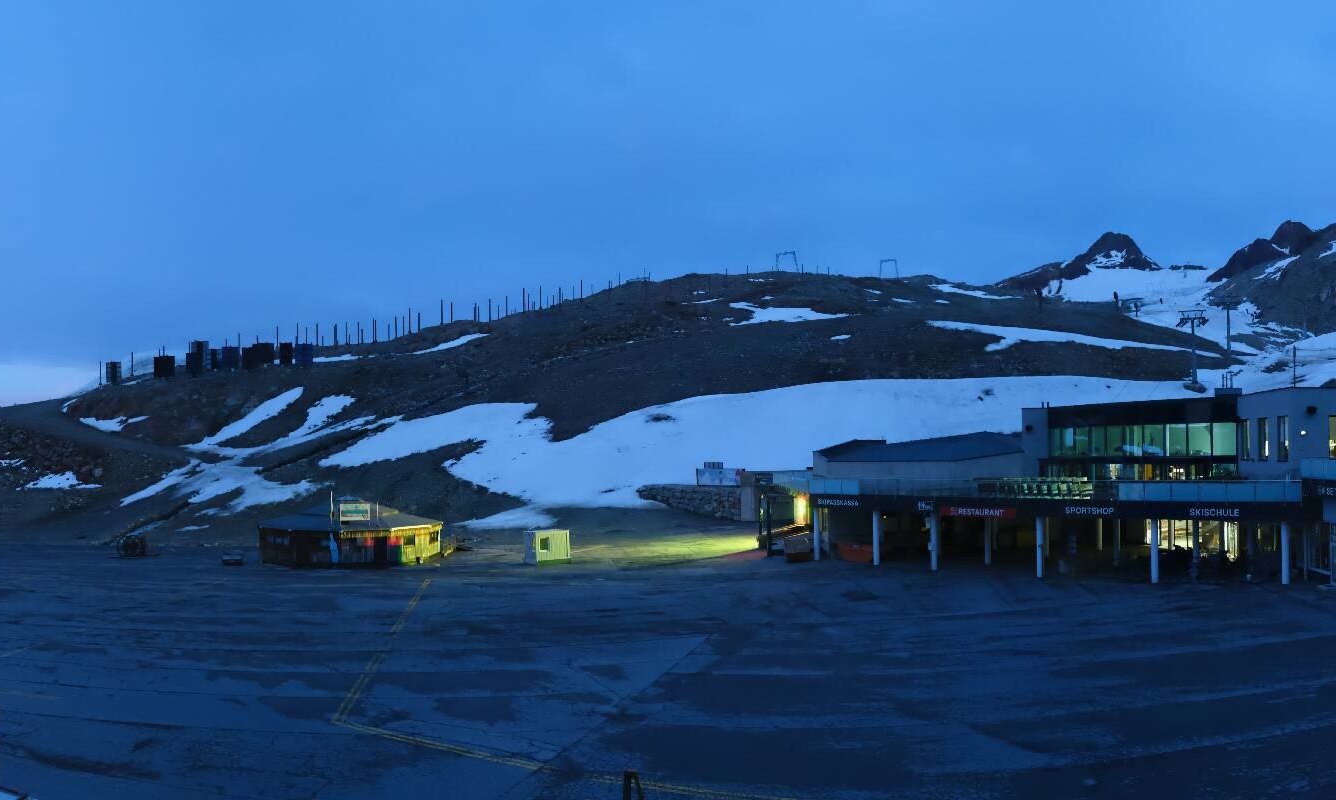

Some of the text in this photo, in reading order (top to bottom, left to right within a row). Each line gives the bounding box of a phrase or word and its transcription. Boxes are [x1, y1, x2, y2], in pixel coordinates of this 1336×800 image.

[817, 498, 859, 507] SKIPASSKASSA
[958, 507, 1005, 517] RESTAURANT
[1065, 506, 1114, 515] SPORTSHOP
[1189, 508, 1240, 517] SKISCHULE
